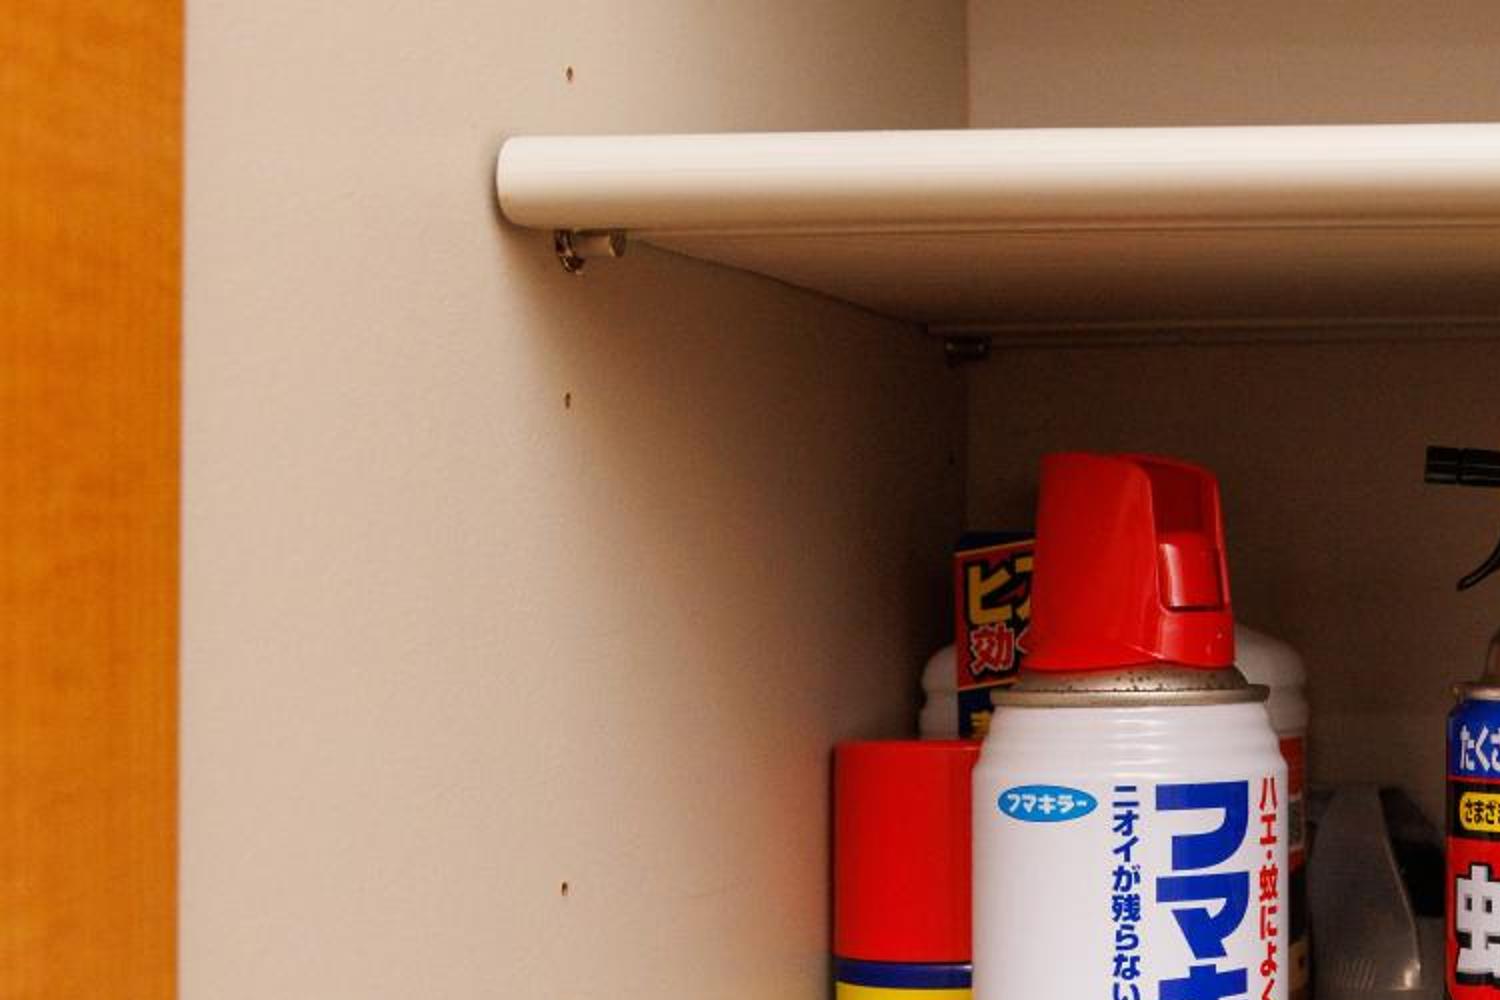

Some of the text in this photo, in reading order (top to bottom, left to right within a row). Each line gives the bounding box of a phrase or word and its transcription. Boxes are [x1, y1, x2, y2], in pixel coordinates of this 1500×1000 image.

[1007, 794, 1087, 815] フマキラー
